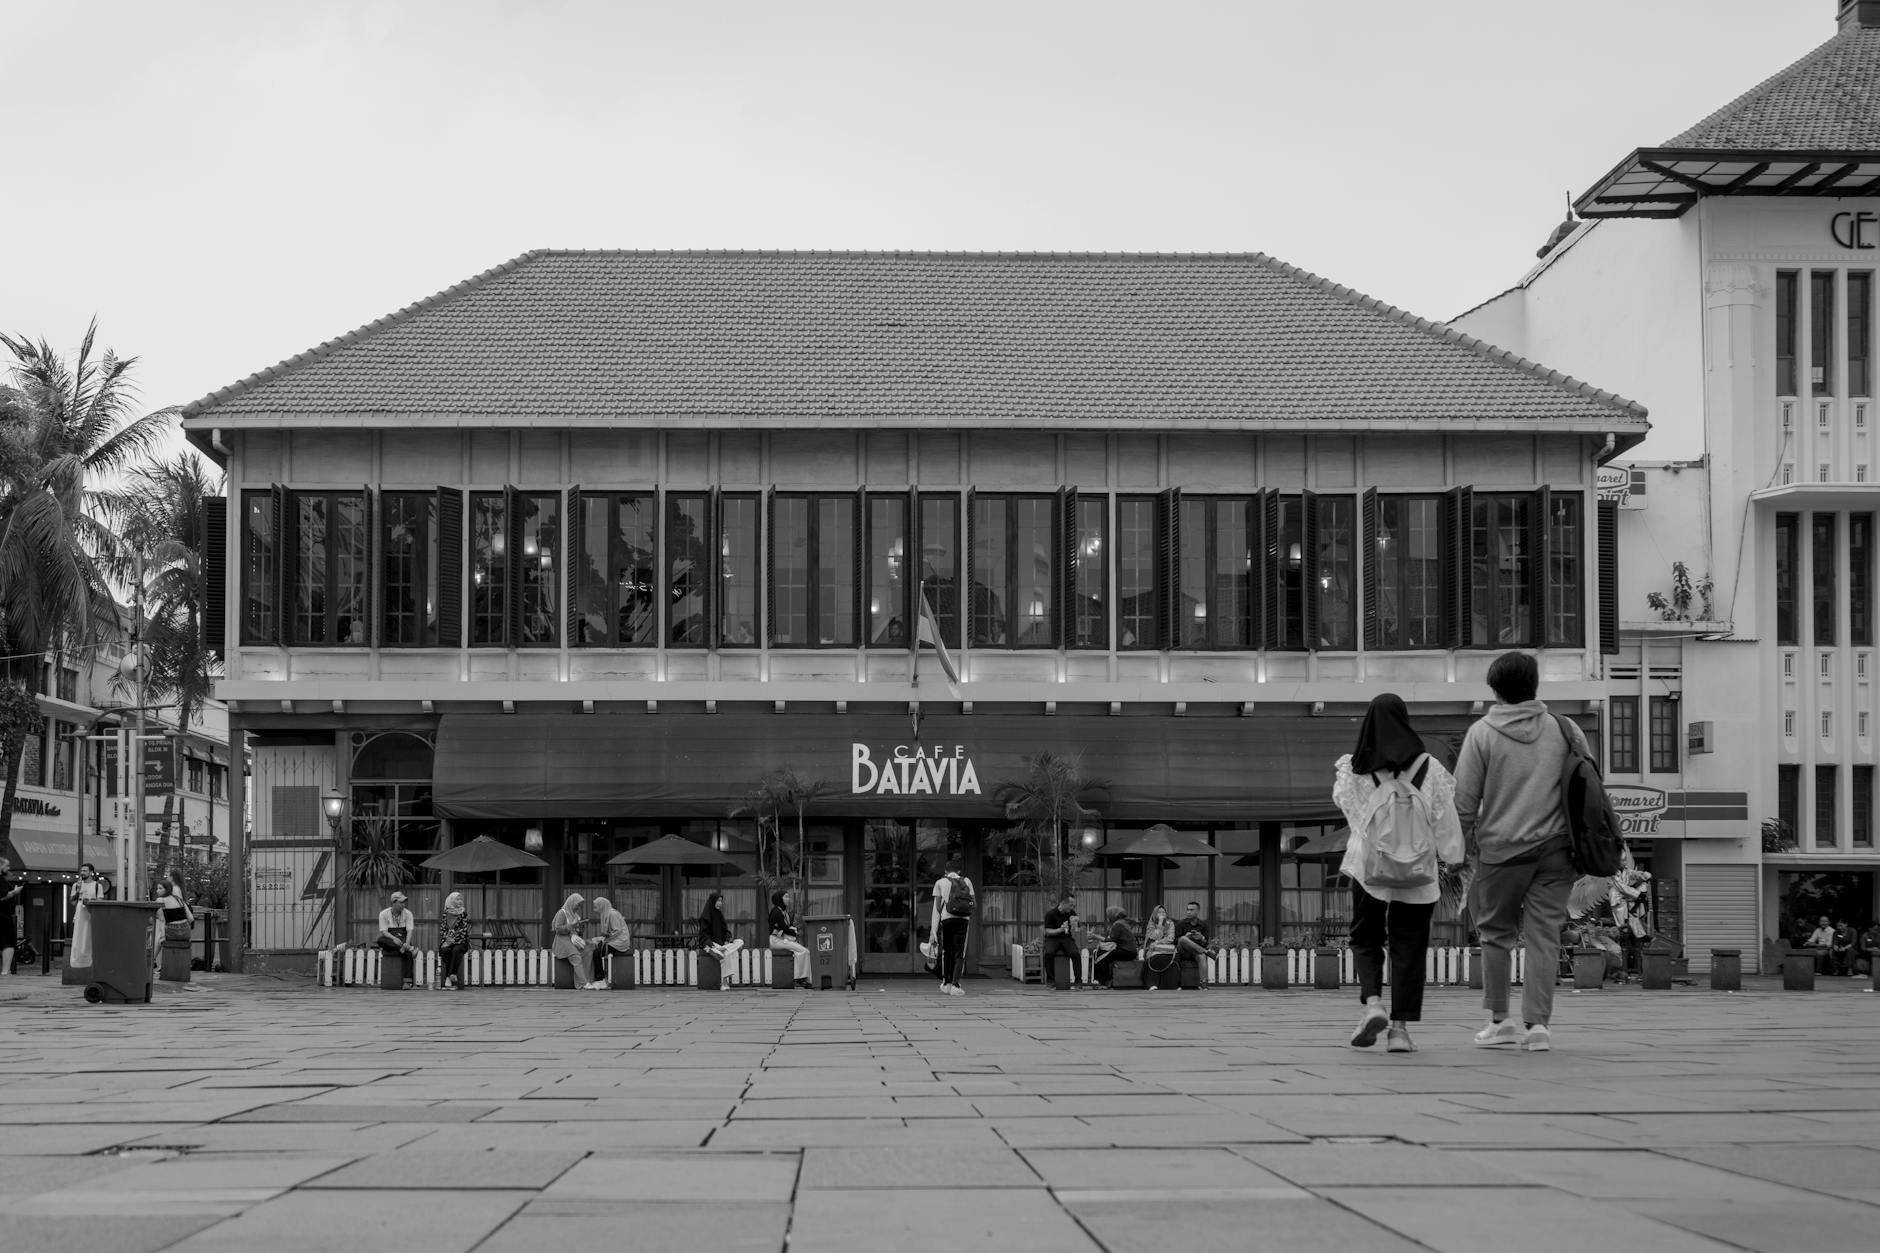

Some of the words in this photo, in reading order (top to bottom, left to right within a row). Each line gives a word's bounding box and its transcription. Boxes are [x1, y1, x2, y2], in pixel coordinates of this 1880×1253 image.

[1598, 473, 1623, 483] aret
[894, 745, 964, 759] CAFE
[852, 743, 982, 794] BATAVIA
[1616, 813, 1660, 833] oint
